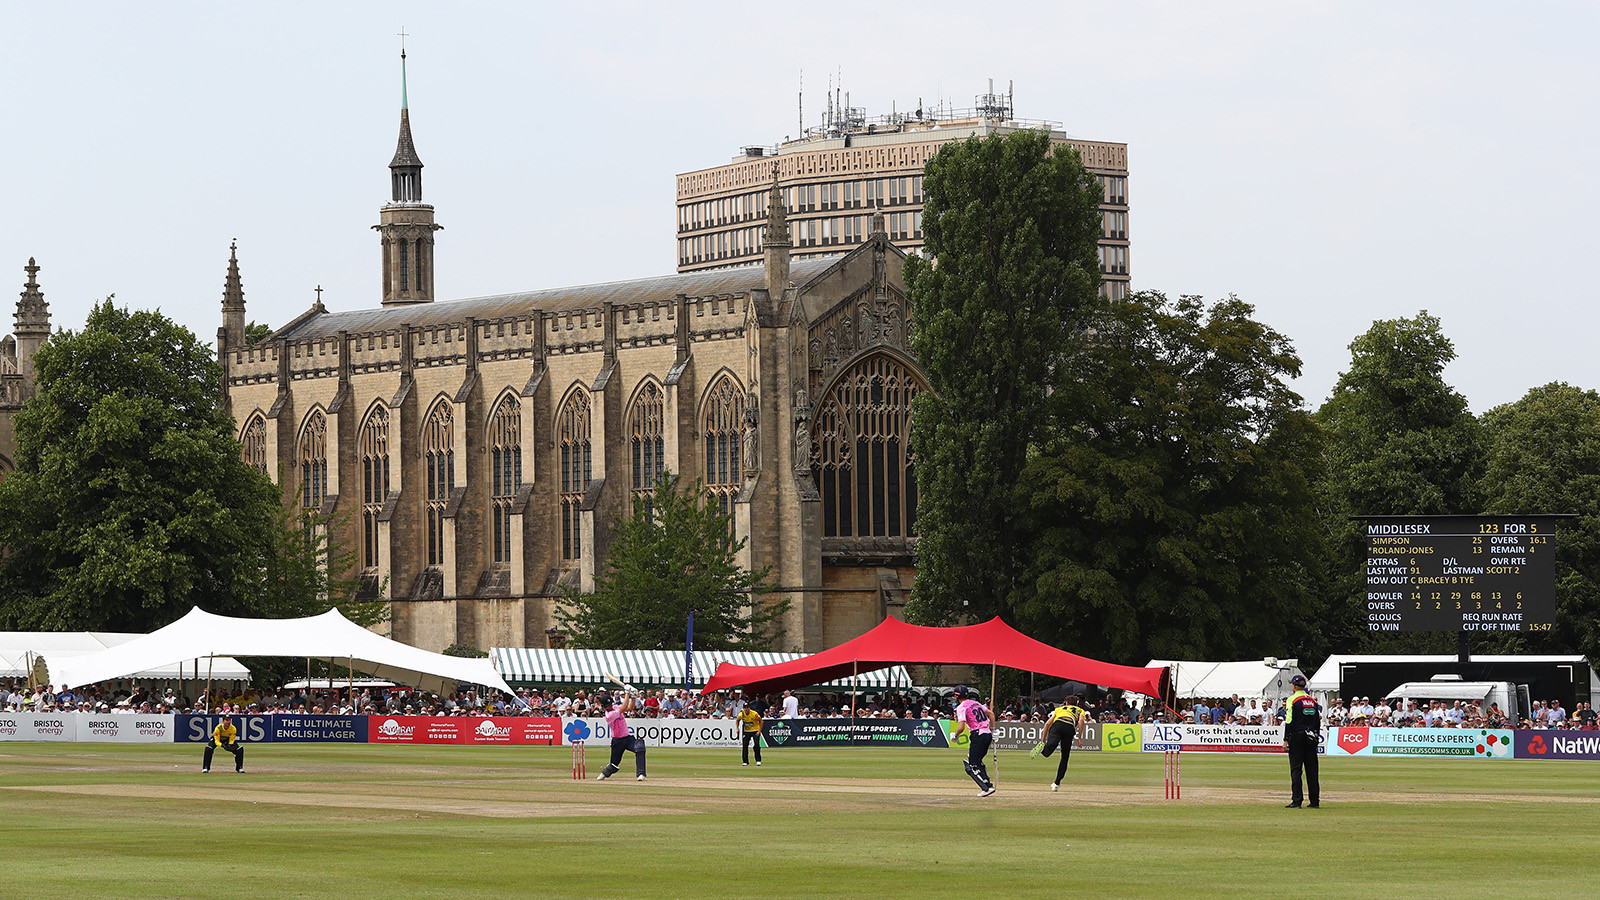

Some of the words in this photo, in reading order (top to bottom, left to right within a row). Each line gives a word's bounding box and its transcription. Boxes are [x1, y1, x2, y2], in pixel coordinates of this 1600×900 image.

[1368, 525, 1430, 534] MIDDLESEX
[1479, 524, 1498, 533] 123
[1504, 524, 1526, 533] FOR
[1530, 524, 1537, 533] 5
[1443, 558, 1458, 566] D/L
[1368, 613, 1401, 621] GLOUCS
[1463, 613, 1480, 622] REQ
[972, 707, 987, 722] 20
[136, 721, 165, 729] BRISTOL
[282, 719, 300, 728] THE
[304, 719, 351, 728] ULTIMATE
[38, 728, 64, 736] energy
[140, 728, 165, 737] energy
[277, 730, 320, 738] ENGLISH
[323, 730, 355, 739] LAGER
[1153, 726, 1182, 741] AES
[1108, 728, 1136, 748] 6a
[1343, 733, 1363, 742] FCC
[1392, 734, 1435, 742] TELECOMS
[1437, 735, 1474, 743] EXPERTS
[1553, 737, 1600, 754] NatW
